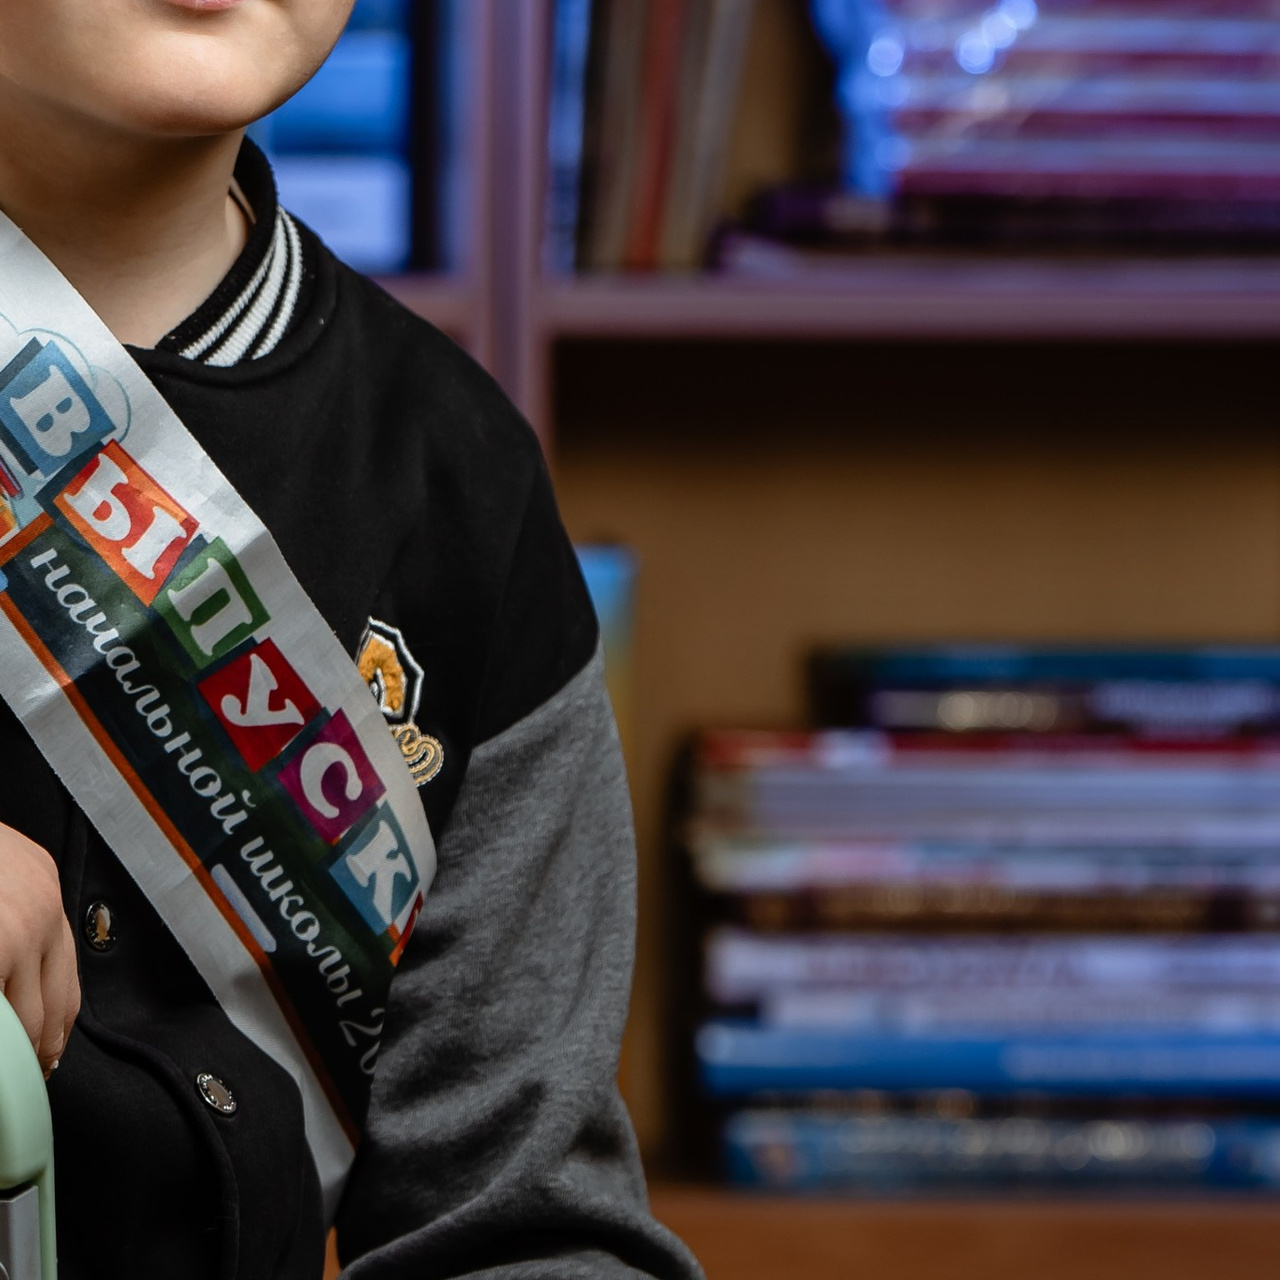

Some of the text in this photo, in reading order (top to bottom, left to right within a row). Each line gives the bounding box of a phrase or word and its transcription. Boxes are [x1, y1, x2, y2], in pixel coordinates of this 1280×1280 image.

[10, 365, 412, 923] ВЫПУСК
[30, 548, 256, 835] начальной
[240, 836, 363, 1008] школы
